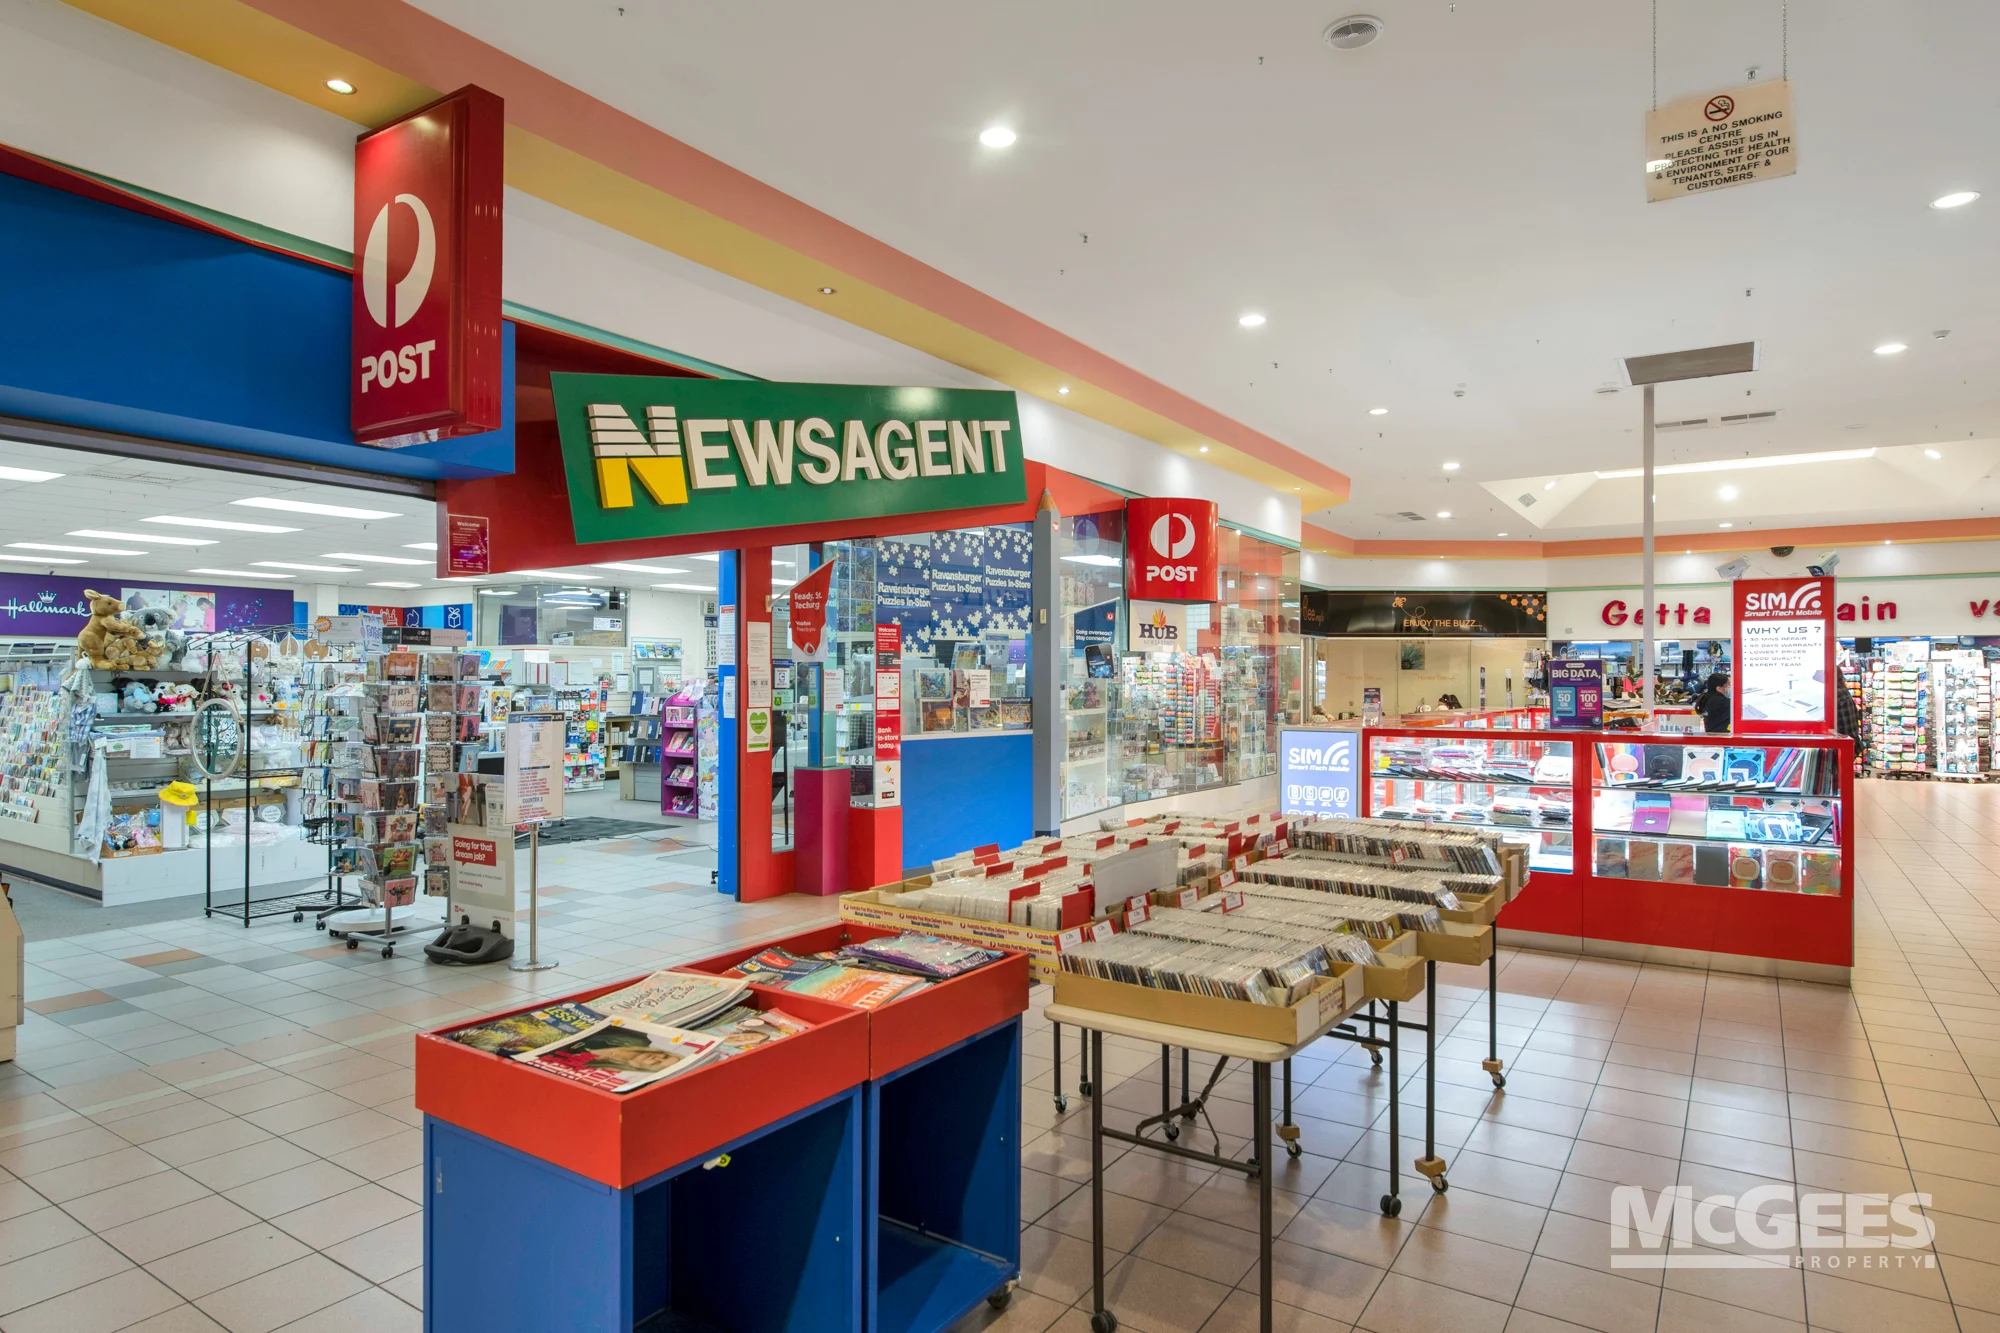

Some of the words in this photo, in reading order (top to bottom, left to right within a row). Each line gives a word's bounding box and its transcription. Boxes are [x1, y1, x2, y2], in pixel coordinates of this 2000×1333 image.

[1661, 133, 1684, 143] THIS
[1688, 130, 1697, 138] IS
[1712, 123, 1728, 132] NO
[1731, 111, 1783, 128] SMOKING
[1699, 129, 1742, 144] CENTRE
[1665, 146, 1704, 159] PLEASE
[1708, 137, 1746, 151] ASSIST
[1750, 133, 1764, 142] US
[1768, 130, 1779, 138] IN
[1654, 152, 1720, 171] PROTECTING
[1724, 146, 1744, 156] THE
[1748, 137, 1791, 152] HEALTH
[1667, 157, 1742, 177] ENVIRONMENT
[1747, 152, 1761, 161] OF
[1766, 146, 1789, 157] OUR
[1727, 161, 1760, 174] STAFF
[1687, 172, 1756, 191] CUSTOMERS.
[361, 339, 436, 394] POST
[587, 404, 1011, 509] NEWSAGENT
[932, 569, 982, 583] Ravensburger
[986, 565, 1031, 579] Ravensburger
[1146, 565, 1198, 582] POST
[878, 582, 930, 597] Ravensburge
[932, 582, 956, 592] Puzzles
[957, 584, 982, 593] In-Store
[985, 578, 1006, 587] Puzzles
[1008, 580, 1031, 589] In-Store
[878, 596, 904, 605] Puzzles
[1746, 593, 1786, 610] SIM
[0, 598, 92, 619] Hallmark
[1602, 600, 1711, 626] Getta
[1404, 619, 1433, 627] ENJOY
[1434, 619, 1451, 627] THE
[1139, 623, 1178, 640] HUB
[1552, 669, 1569, 678] BIG
[1570, 669, 1601, 679] DATA,
[1558, 694, 1570, 702] 50
[1580, 694, 1597, 702] 100
[1289, 748, 1322, 764] SIM
[455, 840, 471, 850] Going
[471, 842, 480, 850] for
[480, 842, 493, 852] that
[455, 850, 473, 860] dream
[473, 852, 486, 861] job?
[1027, 946, 1039, 954] Delivery
[544, 1007, 577, 1023] LESS
